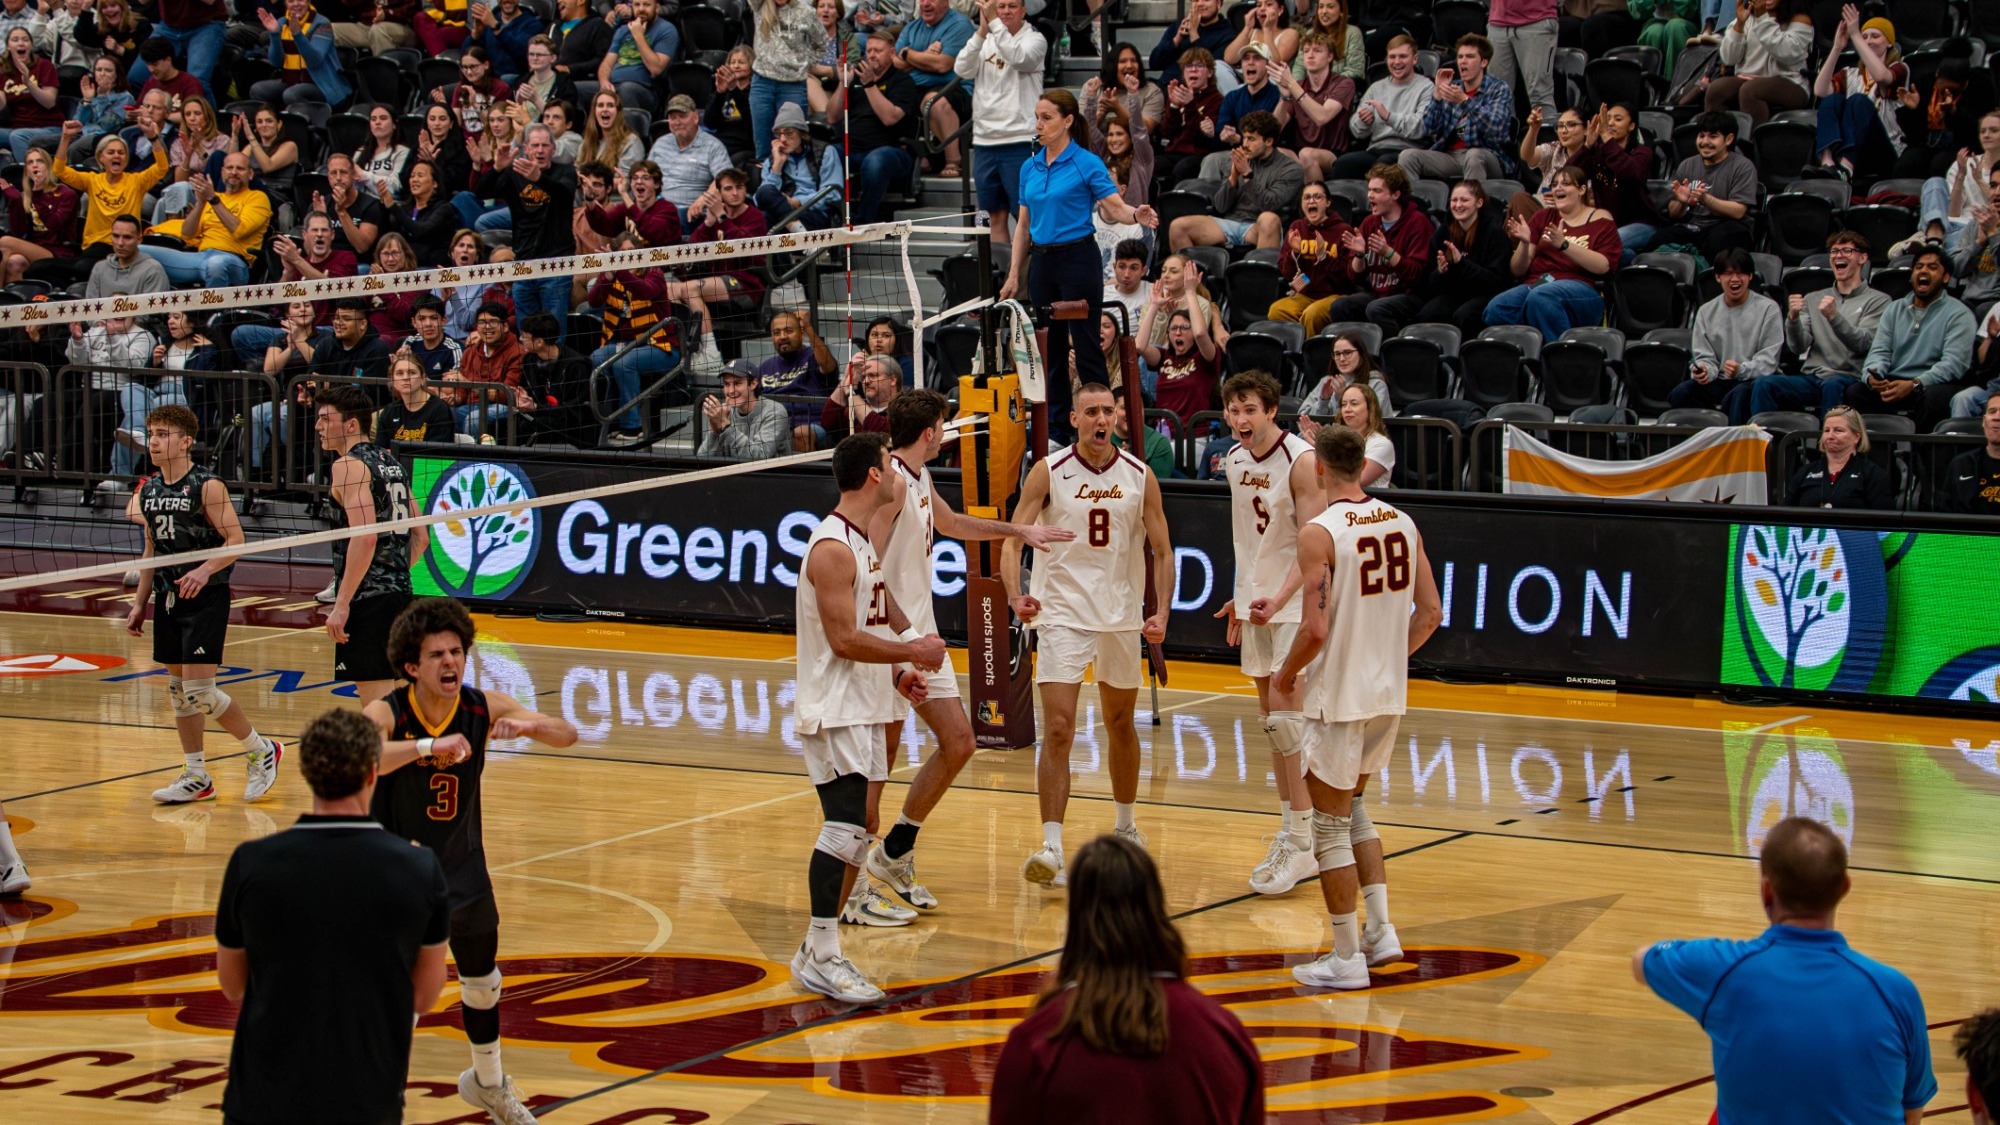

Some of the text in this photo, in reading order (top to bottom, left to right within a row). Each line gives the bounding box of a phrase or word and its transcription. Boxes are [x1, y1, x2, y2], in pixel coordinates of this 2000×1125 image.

[1240, 470, 1271, 491] Loyola
[1074, 483, 1124, 503] Loyola
[144, 497, 191, 512] FLYERS
[1251, 495, 1271, 536] 9
[1344, 508, 1399, 528] Ramblers
[1088, 507, 1111, 548] 8
[1356, 530, 1411, 597] 28
[586, 609, 626, 618] DAKTRONICS
[981, 597, 995, 686] sports imports
[1566, 676, 1616, 686] DAKTRONICS
[427, 772, 459, 821] 3
